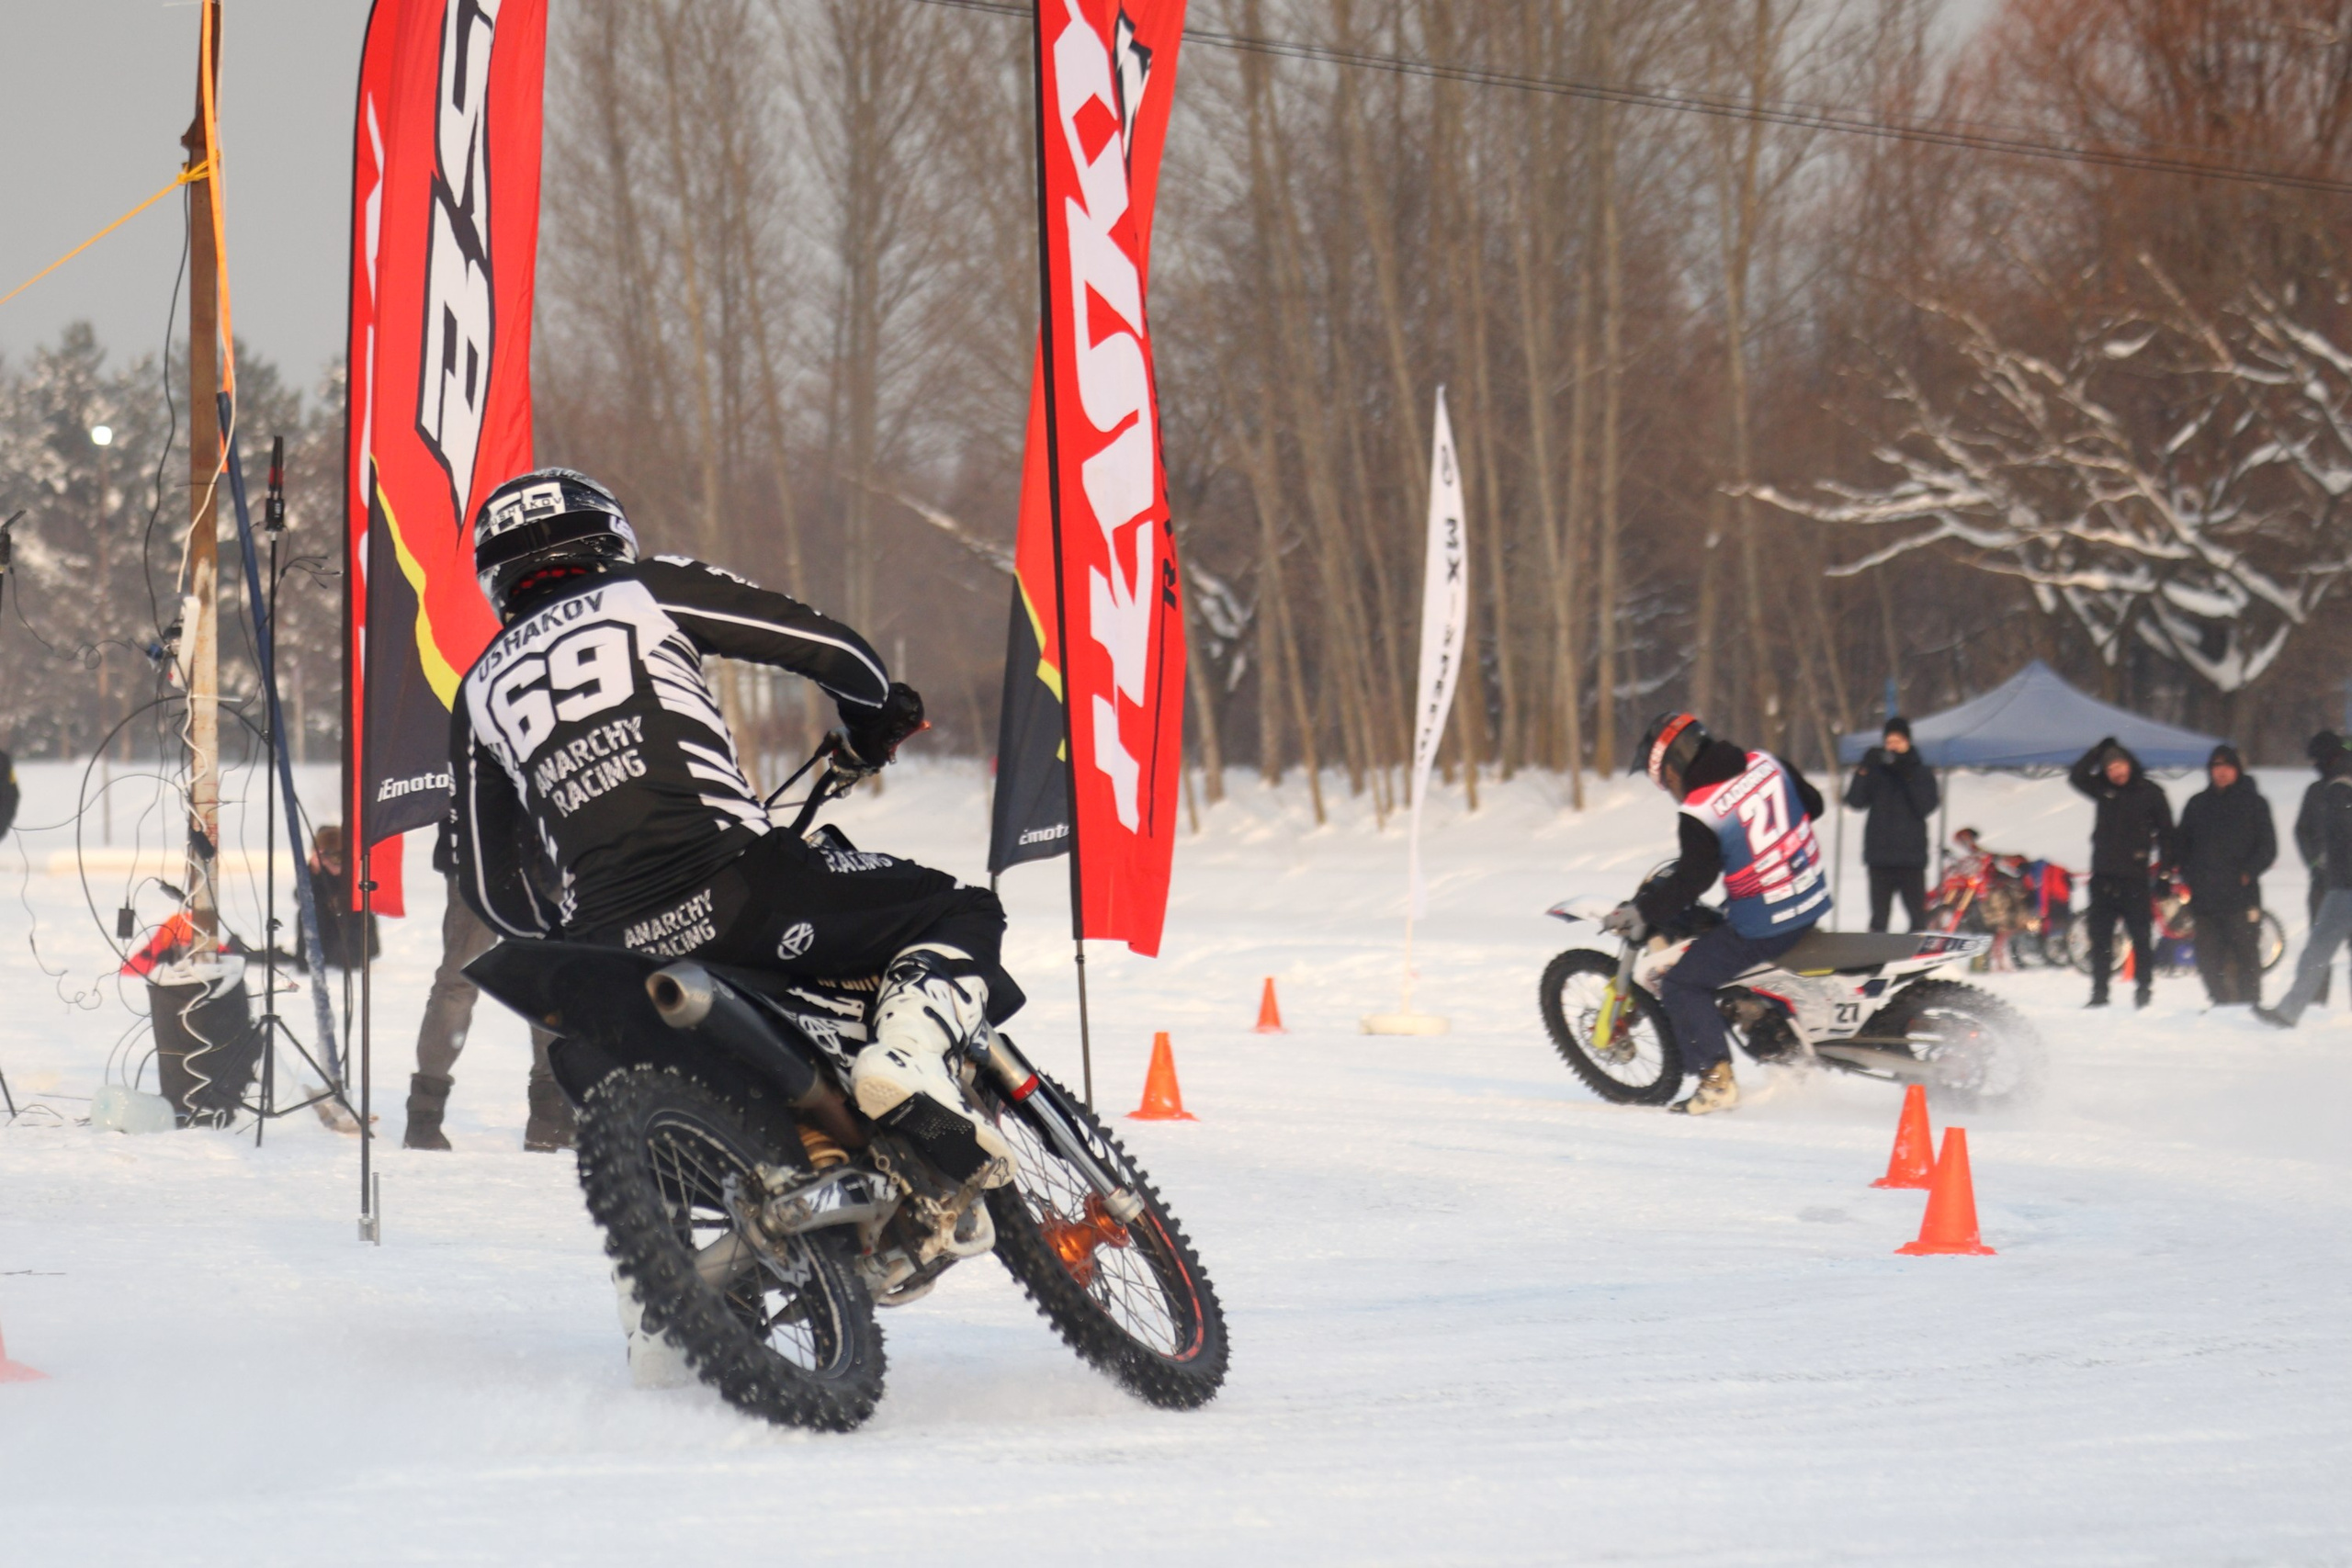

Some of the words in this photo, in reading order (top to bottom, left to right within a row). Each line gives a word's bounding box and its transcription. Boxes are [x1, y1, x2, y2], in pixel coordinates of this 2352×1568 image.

[478, 591, 604, 682] USHAKOV
[490, 626, 635, 763] 69
[534, 716, 644, 798] ANARCHY
[551, 749, 647, 818] RACING
[1737, 774, 1790, 856] 27
[624, 888, 713, 949] ANARCHY
[1835, 1002, 1860, 1023] 27
